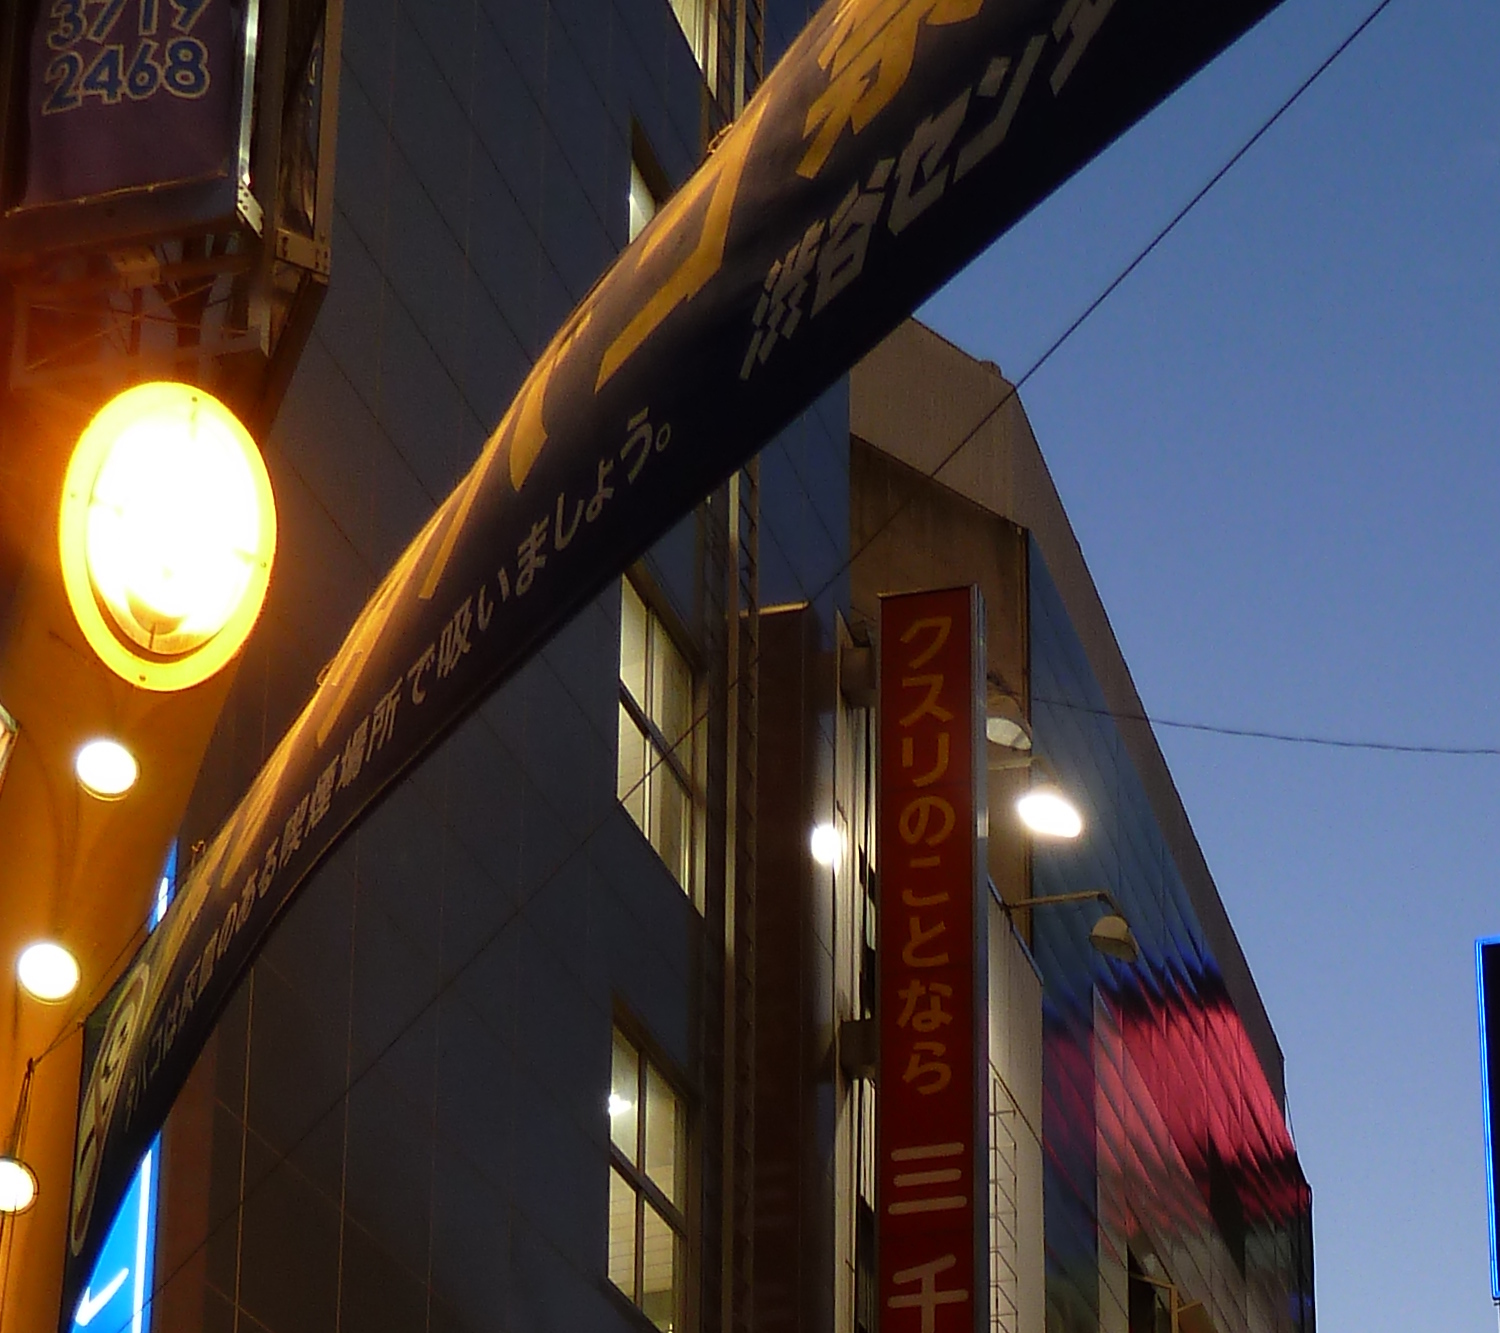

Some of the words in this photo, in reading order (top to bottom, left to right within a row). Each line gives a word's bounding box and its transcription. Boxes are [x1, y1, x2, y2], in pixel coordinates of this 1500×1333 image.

[41, 36, 209, 116] 2468
[897, 614, 955, 1098] クスリのことなら
